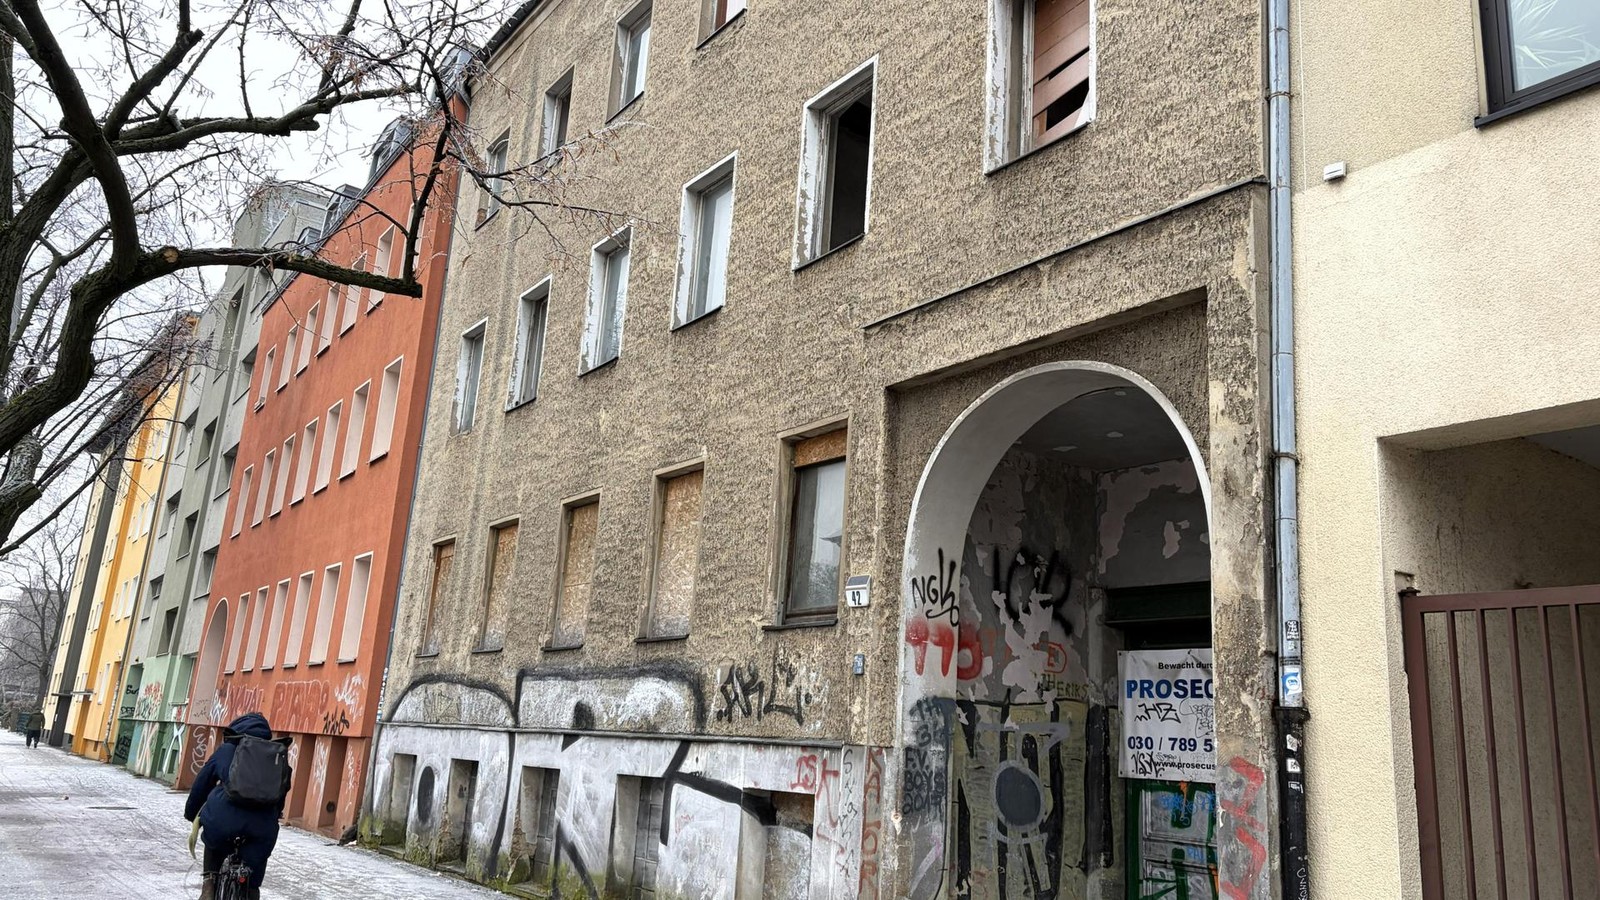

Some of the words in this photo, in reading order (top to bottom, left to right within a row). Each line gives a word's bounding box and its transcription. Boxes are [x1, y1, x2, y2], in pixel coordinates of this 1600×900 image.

[851, 590, 862, 606] 42
[1158, 661, 1194, 670] Bewacht
[1126, 679, 1213, 698] PROSEC
[1127, 735, 1154, 750] 030
[1167, 737, 1198, 752] 789
[1203, 738, 1213, 752] 5
